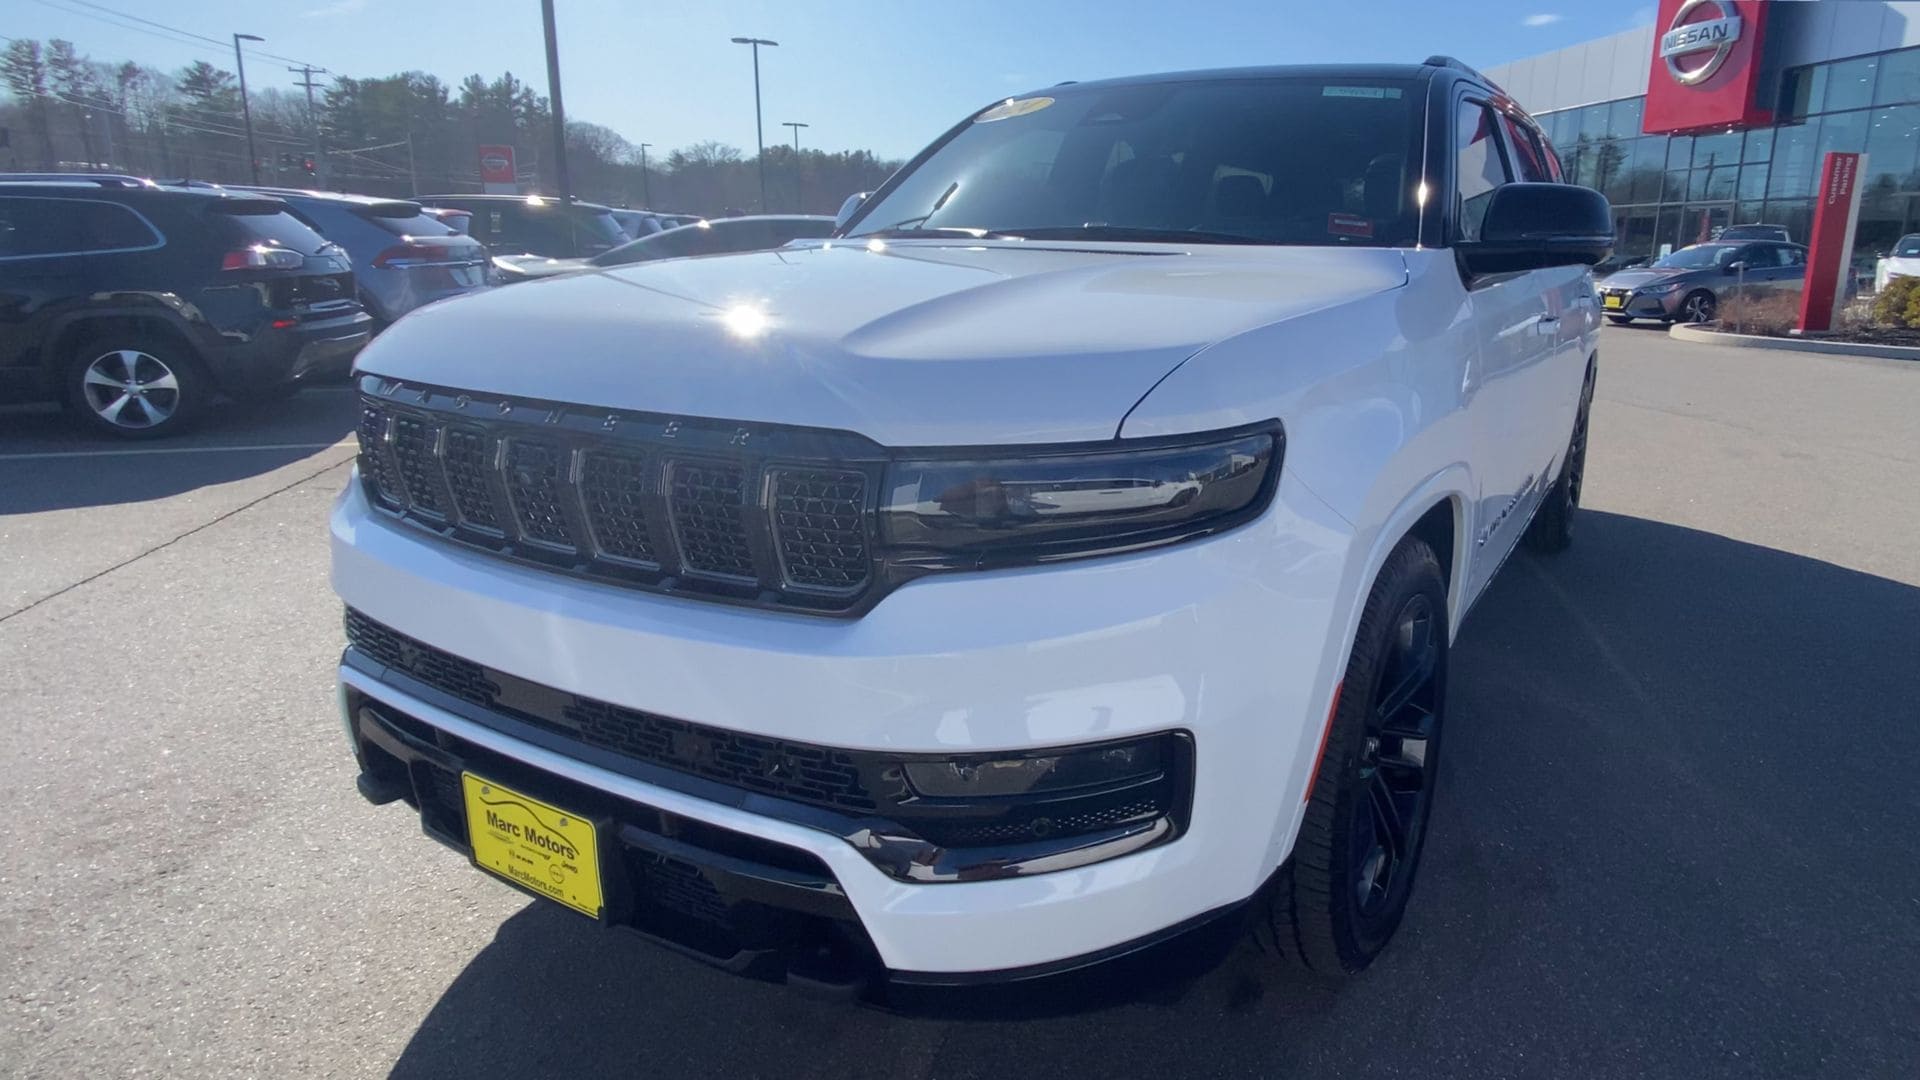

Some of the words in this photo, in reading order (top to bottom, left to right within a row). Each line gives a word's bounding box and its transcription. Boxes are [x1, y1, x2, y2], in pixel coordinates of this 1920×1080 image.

[1664, 23, 1728, 51] NISSAN
[1829, 157, 1842, 205] Customer
[1840, 157, 1853, 195] Parking
[380, 382, 750, 446] WAGONEER
[486, 809, 521, 837] Marc
[524, 825, 575, 860] Motors
